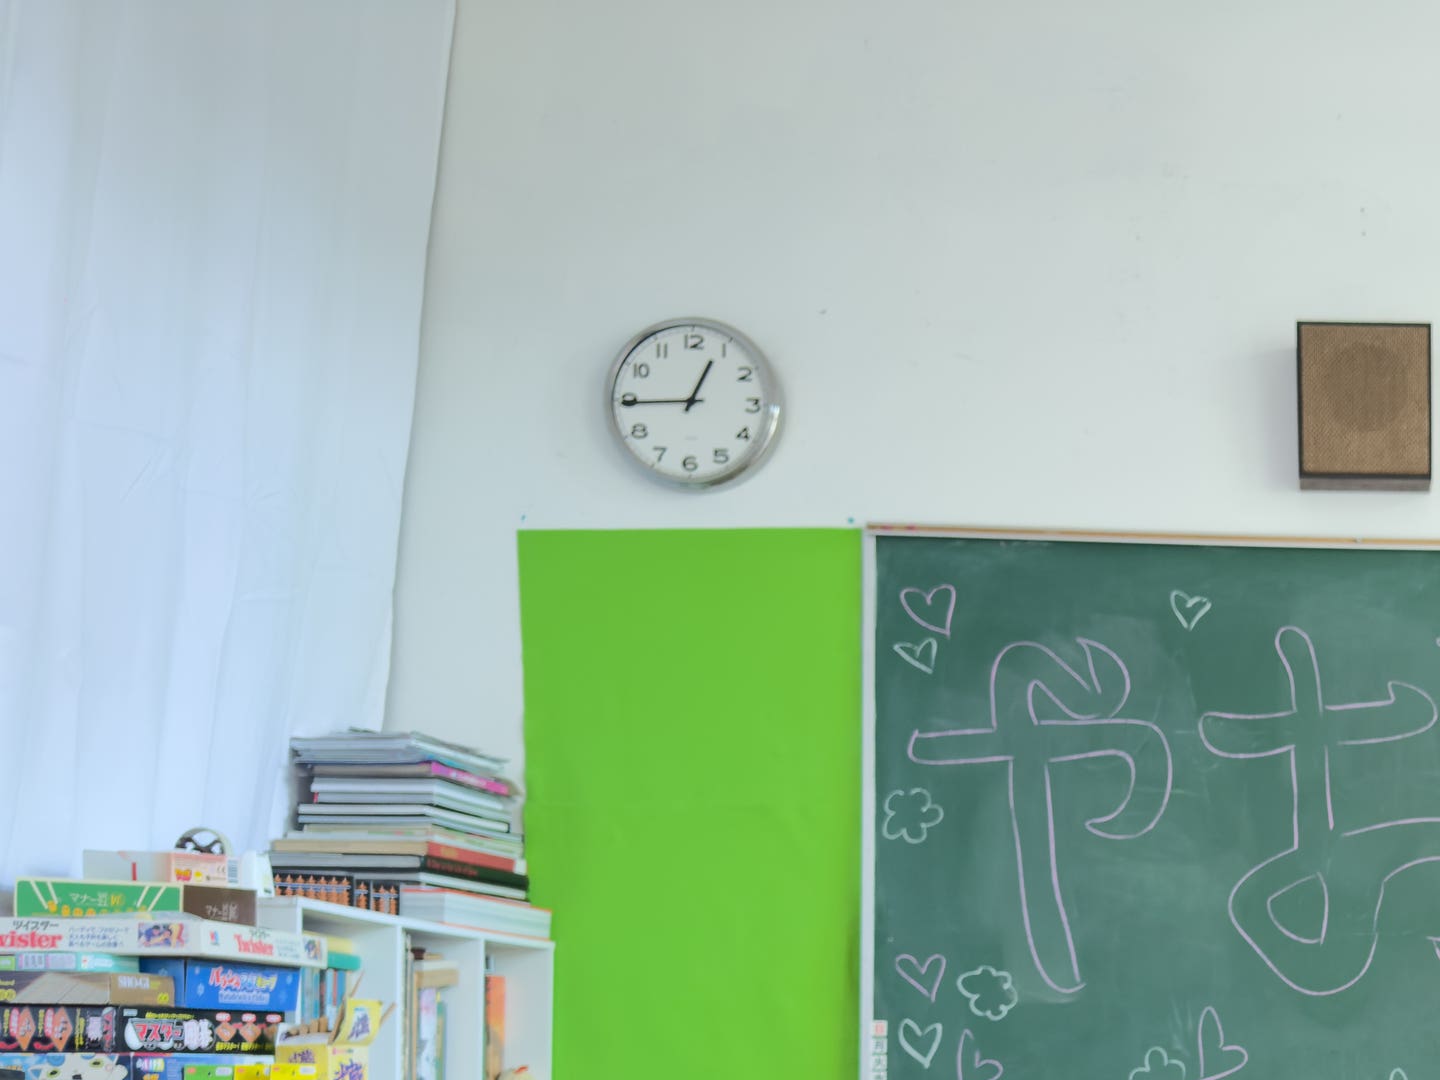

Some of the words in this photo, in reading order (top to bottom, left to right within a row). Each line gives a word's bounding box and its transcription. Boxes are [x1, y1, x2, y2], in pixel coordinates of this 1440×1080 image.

[683, 334, 704, 350] 12
[656, 343, 668, 358] 11
[721, 343, 726, 358] 1
[633, 363, 649, 378] 10
[736, 367, 752, 382] 2
[745, 398, 761, 413] 3
[631, 423, 648, 439] 8
[736, 427, 750, 441] 4
[653, 446, 667, 462] 7
[713, 448, 729, 464] 5
[682, 456, 698, 471] 6
